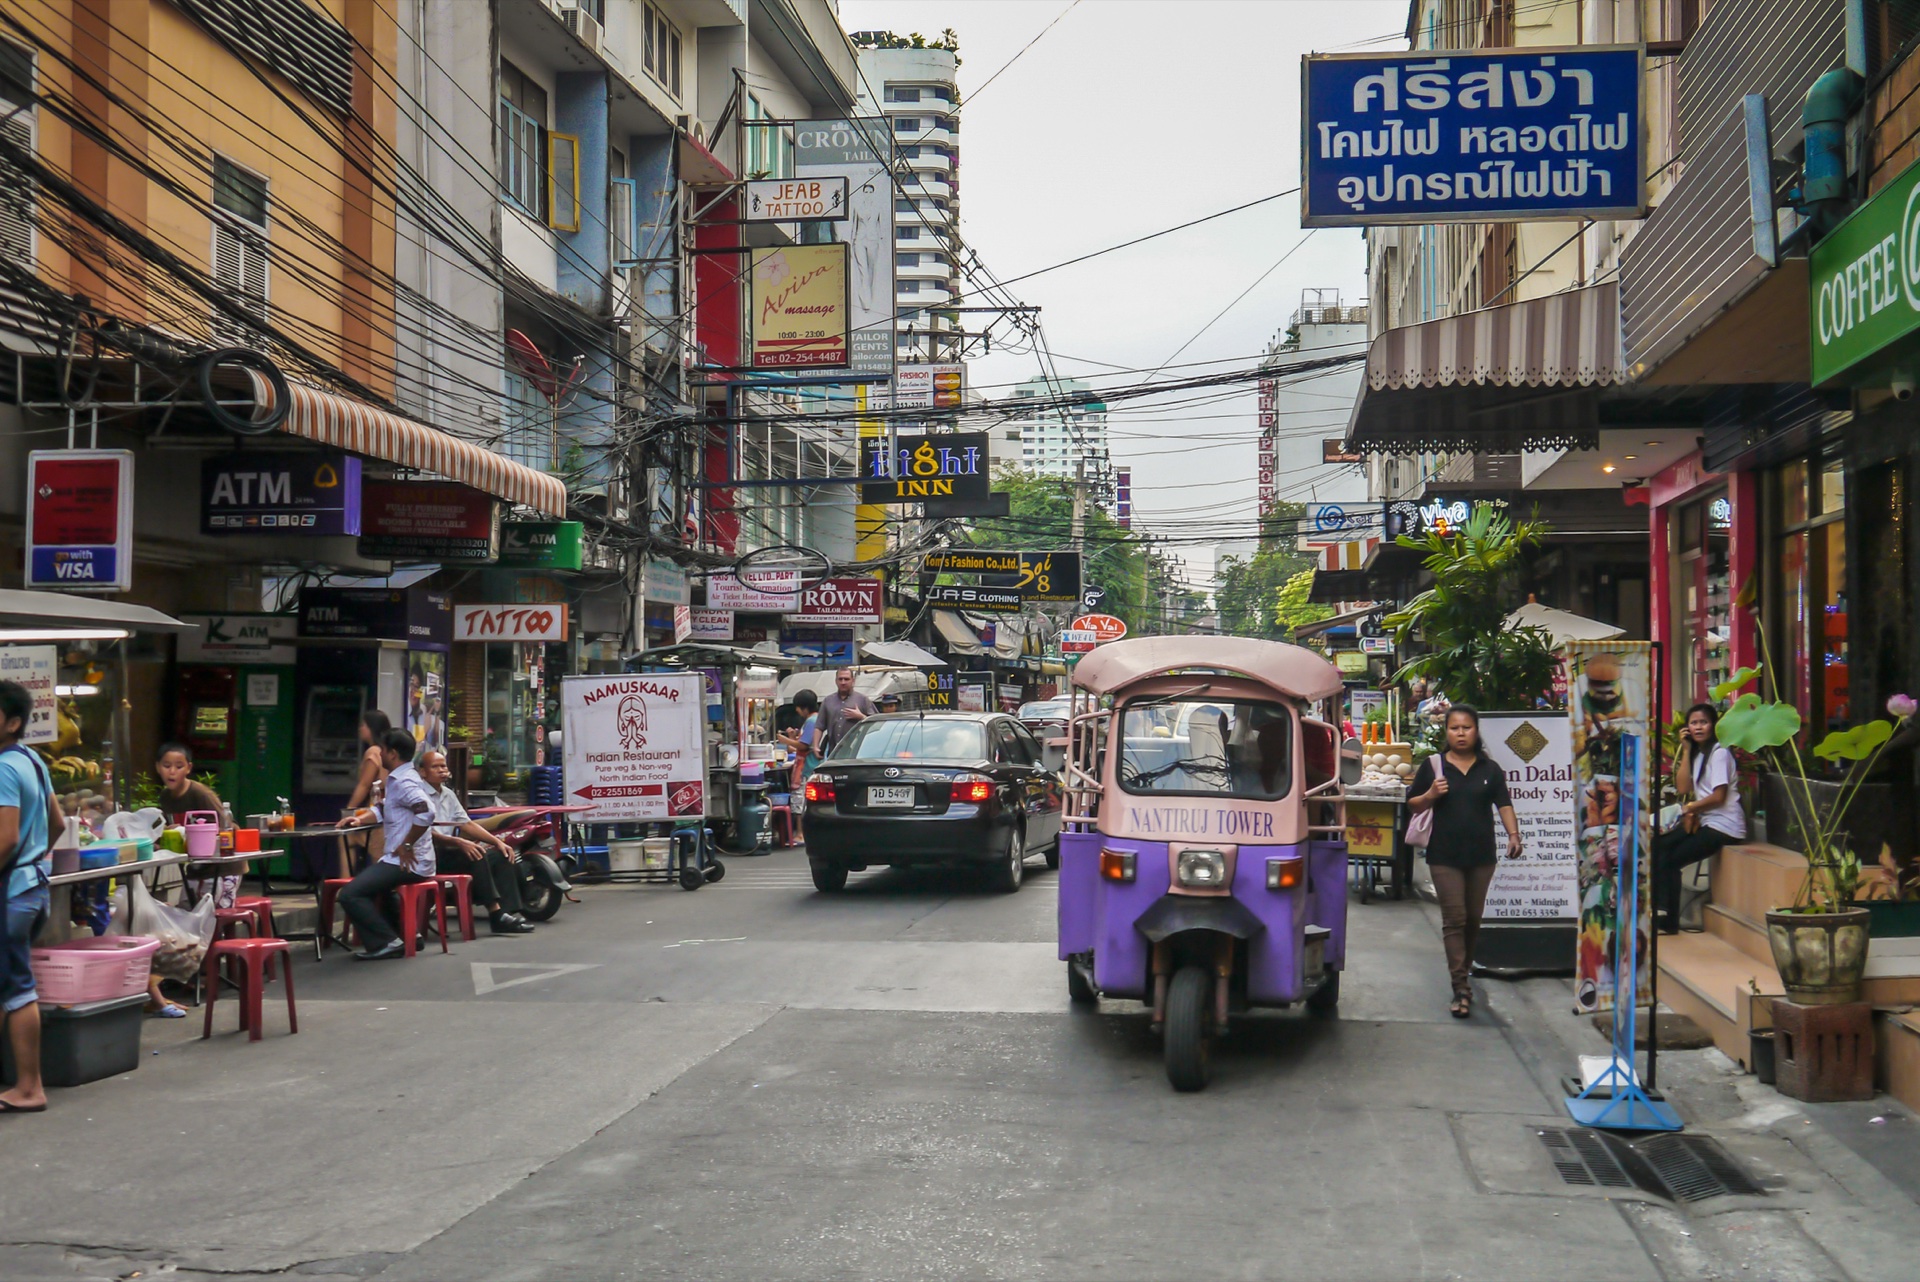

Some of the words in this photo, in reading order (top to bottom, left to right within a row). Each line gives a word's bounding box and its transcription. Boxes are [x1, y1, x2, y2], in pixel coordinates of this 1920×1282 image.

[1353, 56, 1594, 113] ศรีสง่า
[797, 130, 889, 149] CROWN
[1317, 118, 1439, 159] โคมไฟ
[1460, 113, 1628, 154] หลอดไฟ
[843, 151, 889, 161] TAILOR
[773, 182, 820, 200] JEAB
[1338, 158, 1611, 211] อุปกรณ์ไฟฟ้า
[765, 202, 823, 217] TATTOO
[762, 265, 833, 326] Aviva
[1819, 232, 1898, 346] COFFEE
[785, 304, 835, 318] massage
[779, 331, 797, 339] 10:00
[805, 330, 825, 338] 23:00
[853, 342, 888, 351] GENTS
[760, 354, 777, 364] Tel:
[779, 352, 842, 363] 02-254-4487
[210, 472, 291, 504] ATM
[896, 479, 954, 496] INN
[378, 518, 412, 526] ROOMS
[414, 520, 467, 528] AVAILABLE
[530, 533, 556, 545] ATM
[70, 550, 93, 560] with
[925, 554, 949, 567] Tom's
[951, 556, 984, 568] Fashion
[986, 558, 1018, 570] Co.,Ltd.
[54, 563, 94, 578] VISA
[714, 583, 742, 591] Tourist
[1037, 575, 1050, 593] 8
[804, 590, 874, 606] ROWN
[926, 589, 976, 600] JAS
[979, 594, 1019, 603] CLOTHING
[308, 608, 338, 621] ATM
[465, 609, 553, 636] TATTOO
[1081, 618, 1098, 630] Via
[206, 618, 233, 642] K
[238, 627, 268, 638] ATM
[582, 680, 679, 706] NAMUSKAAR
[586, 752, 620, 763] Indian
[624, 750, 680, 762] Restaurant
[639, 763, 672, 772] Non-veg
[600, 774, 620, 782] North
[591, 787, 643, 797] 02-2551869
[1131, 808, 1209, 834] NANTIRUJ
[1217, 810, 1274, 838] TOWER
[1536, 817, 1572, 825] Wellness
[1538, 830, 1572, 838] Therapy
[1538, 841, 1569, 850] Waxing
[1531, 898, 1568, 907] Midnight
